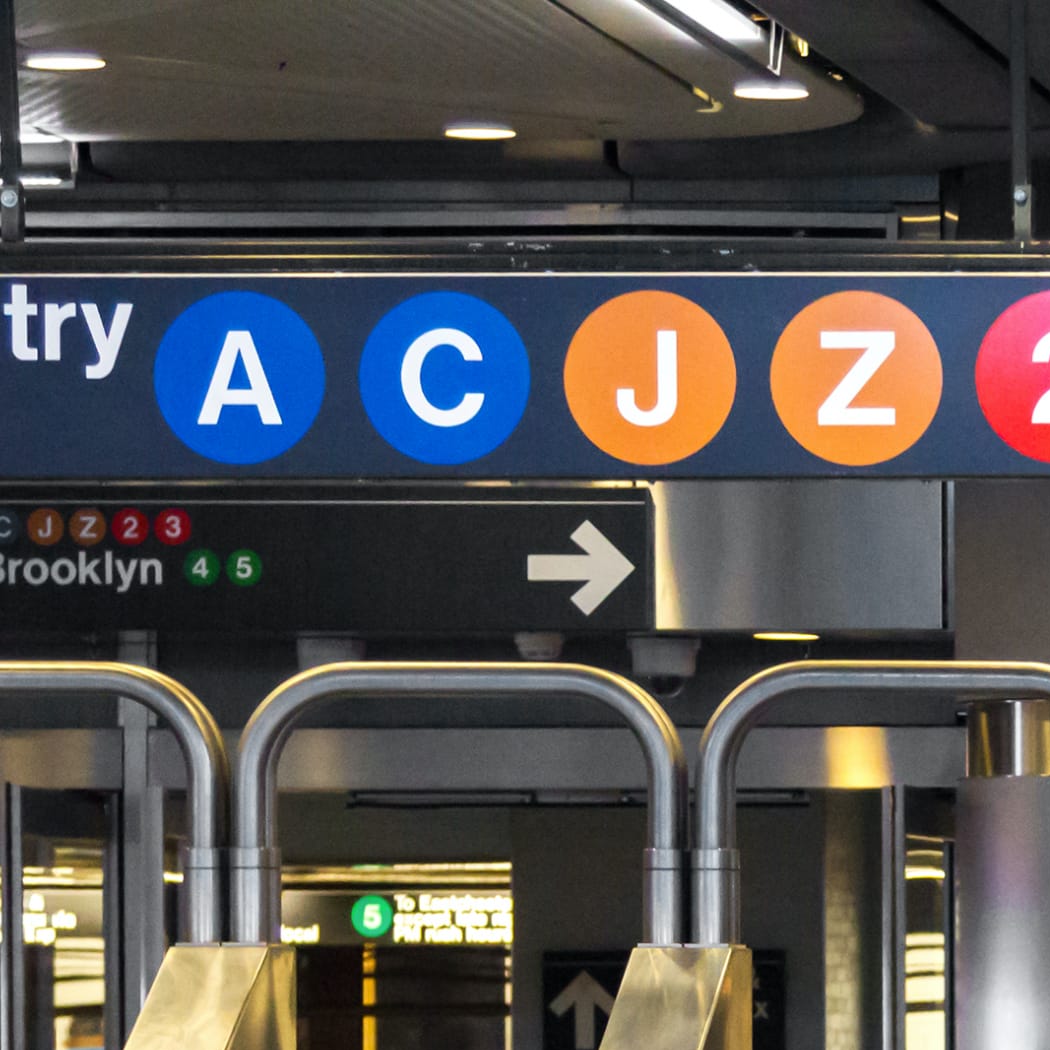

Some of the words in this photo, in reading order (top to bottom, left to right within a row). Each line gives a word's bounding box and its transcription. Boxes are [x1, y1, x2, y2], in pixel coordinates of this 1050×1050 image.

[3, 284, 133, 380] try
[197, 330, 283, 425] A
[400, 327, 485, 427] C
[616, 329, 677, 427] J
[817, 330, 896, 426] Z
[37, 515, 52, 538] J
[79, 515, 97, 538] Z
[123, 516, 139, 538] 2
[165, 515, 181, 538] 3
[0, 551, 163, 593] rooklyn
[192, 557, 209, 579] 4
[236, 556, 254, 579] 5
[363, 903, 383, 930] 5
